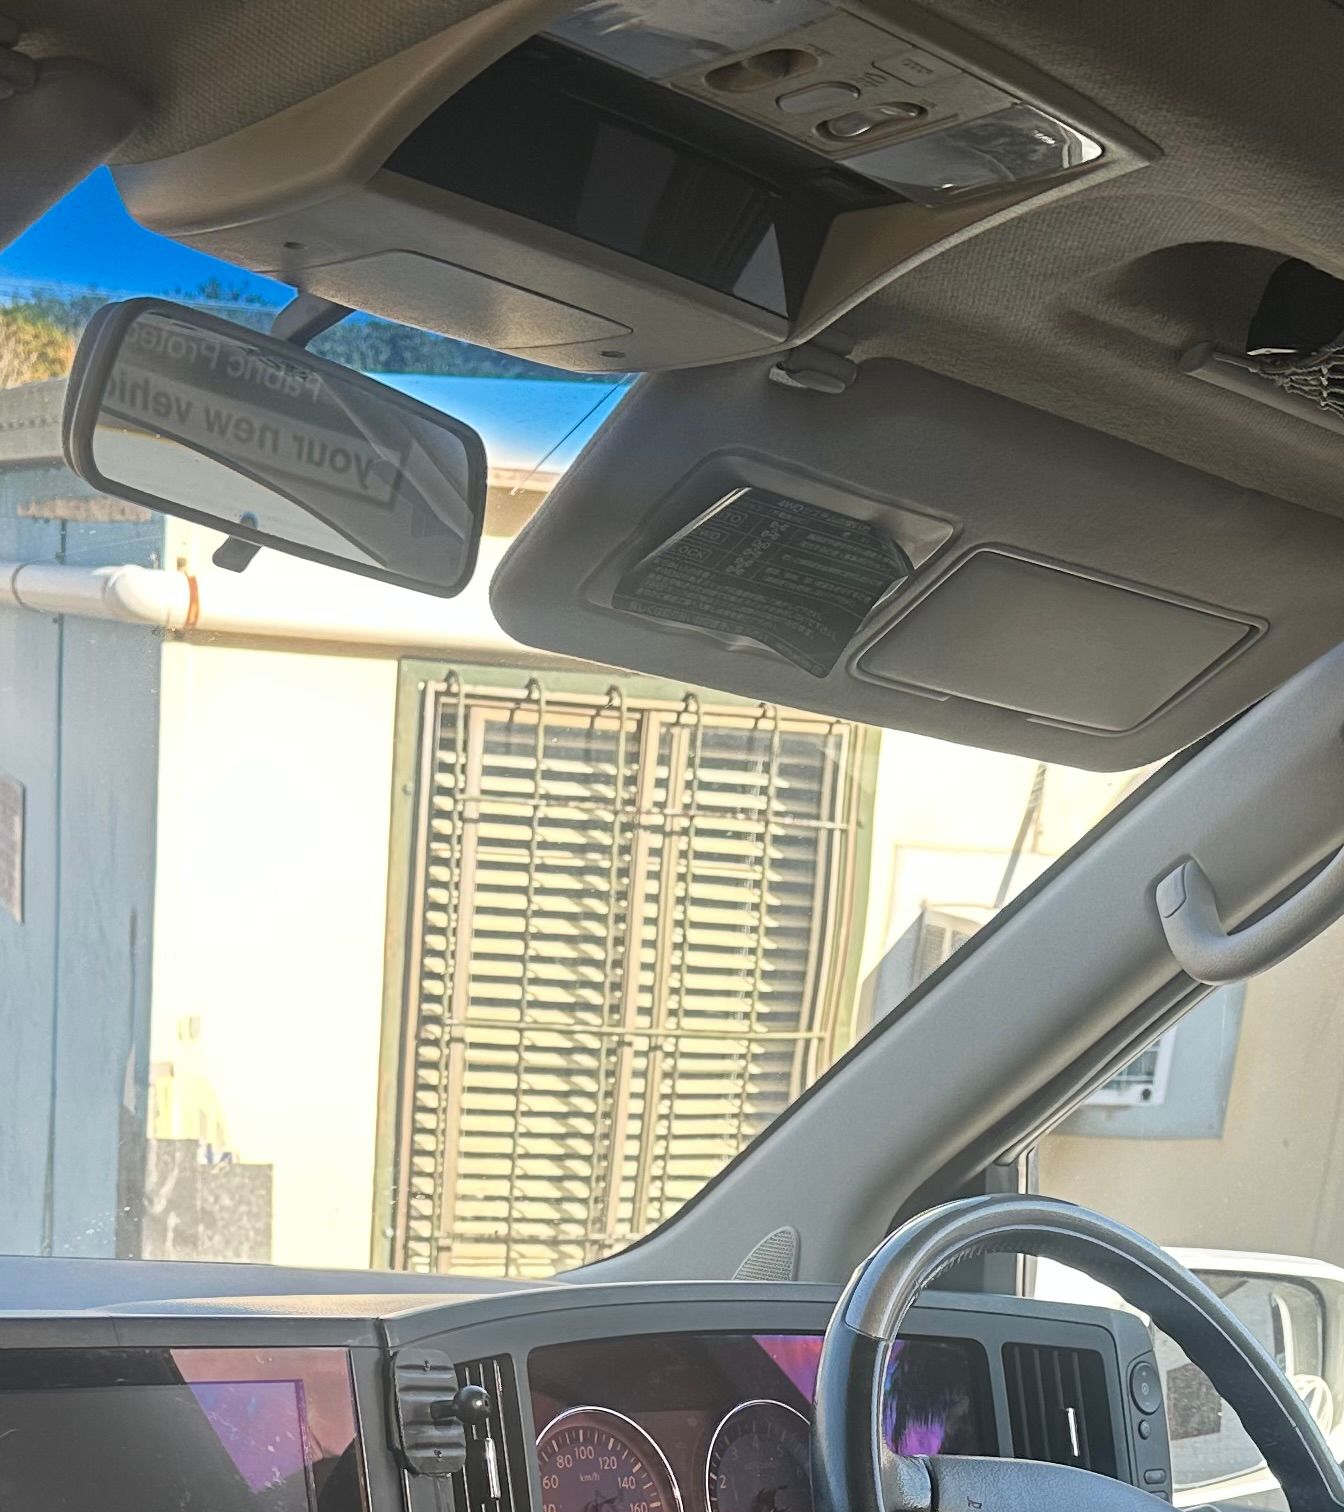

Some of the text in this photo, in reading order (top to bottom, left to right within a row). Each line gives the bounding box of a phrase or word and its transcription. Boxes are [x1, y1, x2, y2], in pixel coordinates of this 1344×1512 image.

[575, 1446, 594, 1459] 100
[556, 1454, 573, 1469] 80
[599, 1456, 617, 1470] 120
[543, 1474, 559, 1489] 60
[618, 1476, 636, 1489] 140
[719, 1475, 727, 1489] 2
